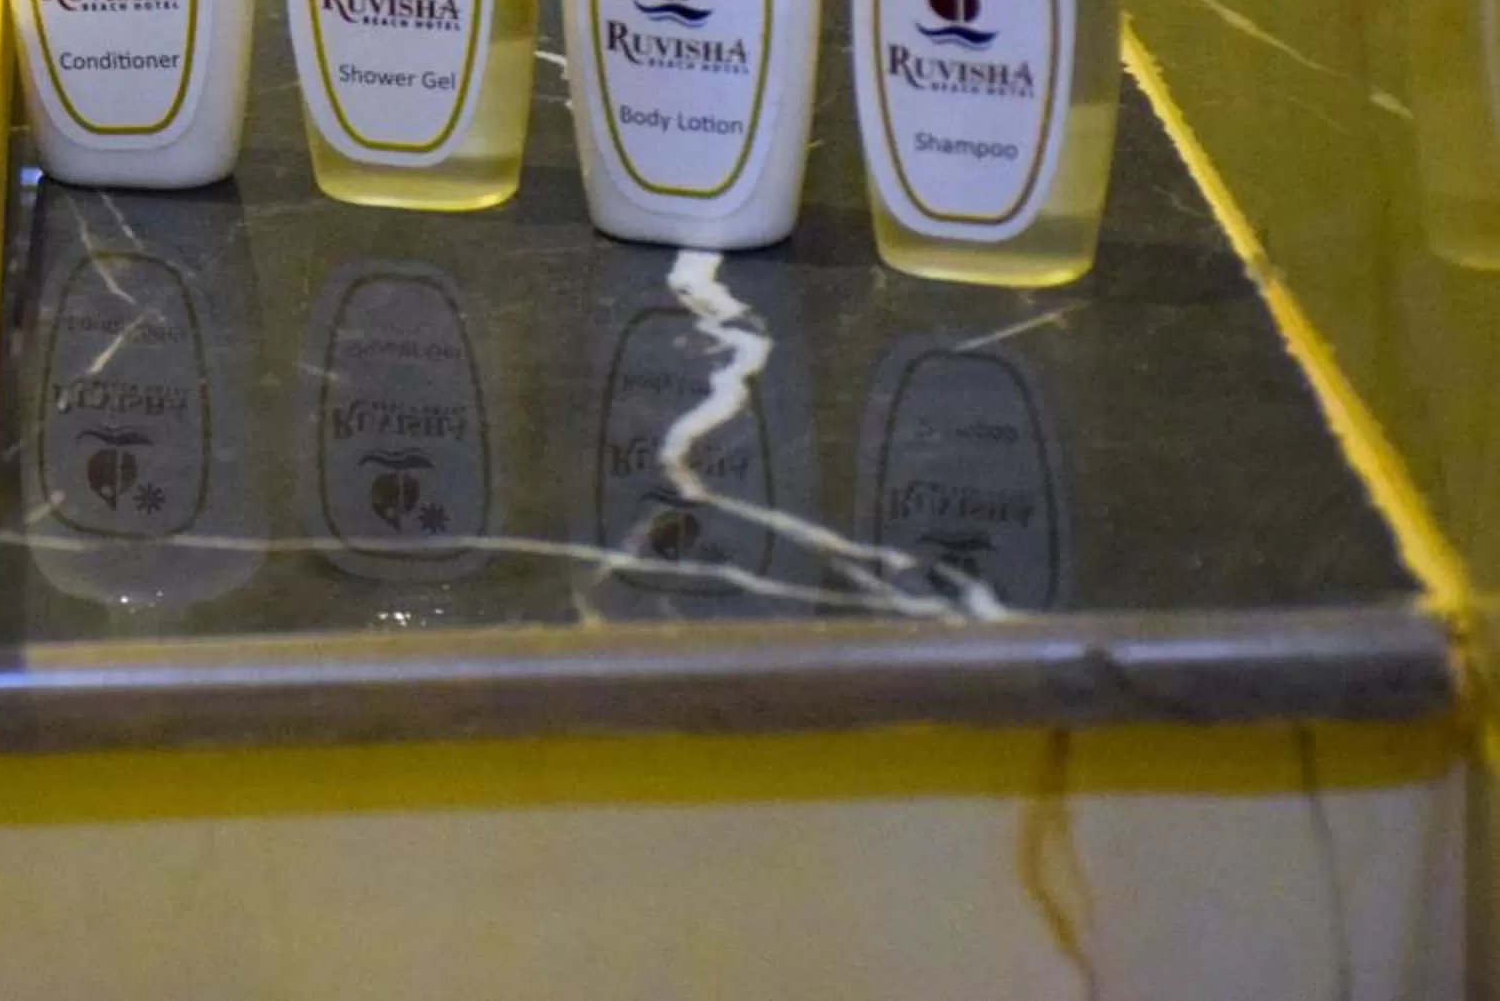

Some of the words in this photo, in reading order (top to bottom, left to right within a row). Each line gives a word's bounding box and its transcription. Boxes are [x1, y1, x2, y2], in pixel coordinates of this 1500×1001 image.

[82, 2, 128, 12] BEACH
[133, 1, 180, 11] HOTEL
[606, 20, 747, 65] RUVISHA
[60, 50, 180, 71] Conditioner
[888, 44, 1033, 90] RUVISHA
[338, 63, 417, 88] Shower
[420, 70, 457, 90] Gel
[620, 104, 673, 135] Body
[676, 110, 744, 135] Lotion
[914, 130, 1020, 161] Shampoo
